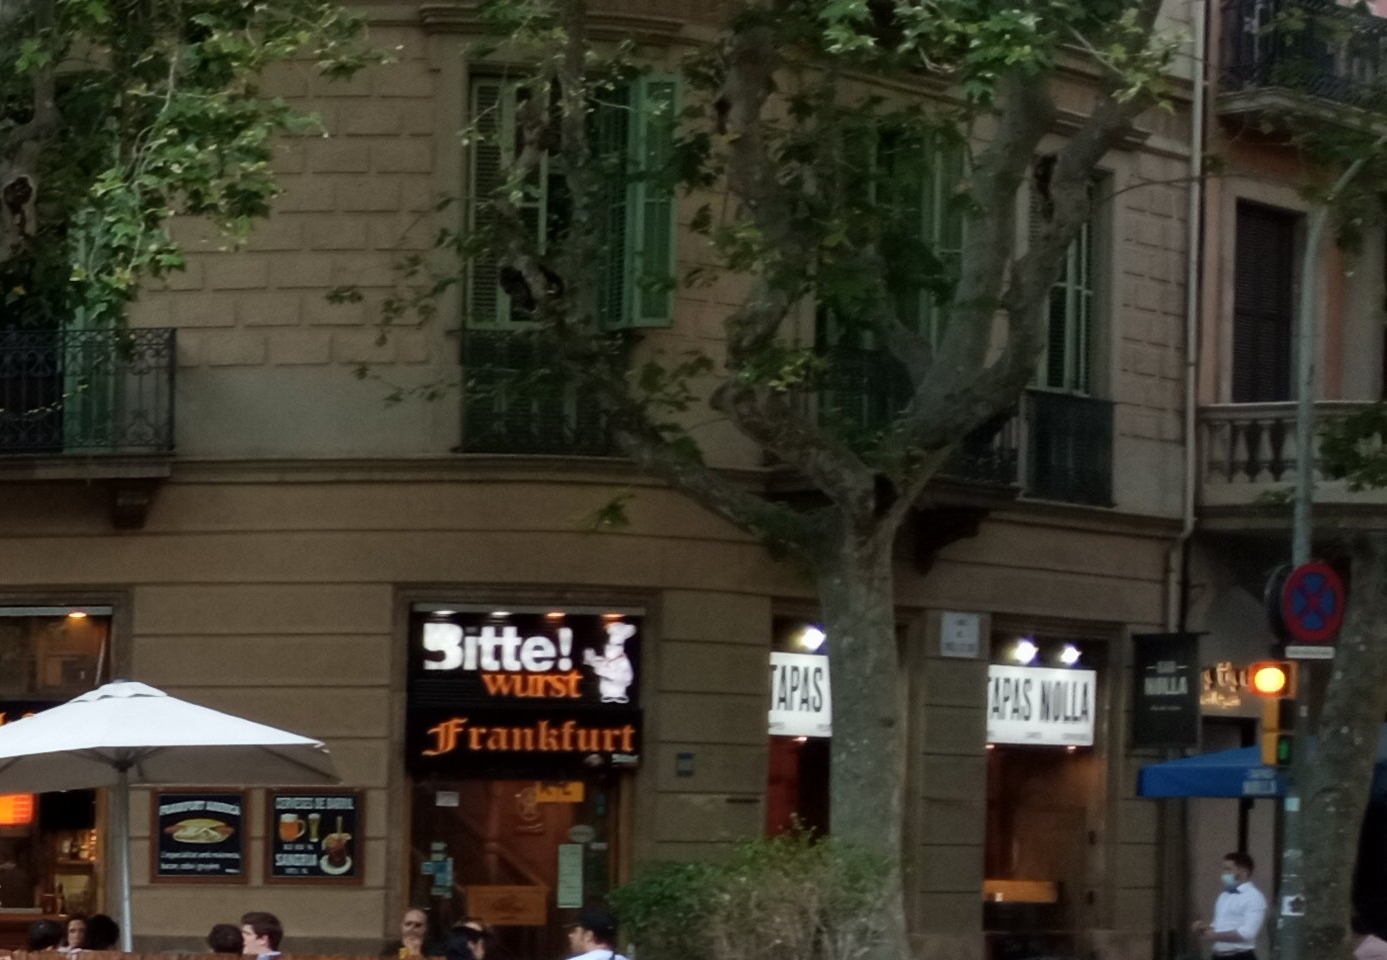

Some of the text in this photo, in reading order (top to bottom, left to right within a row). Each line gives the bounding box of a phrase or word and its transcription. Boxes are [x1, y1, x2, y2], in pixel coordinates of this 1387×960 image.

[423, 622, 573, 672] Bitte!
[481, 670, 584, 698] wurst
[1040, 680, 1089, 723] NOLLA
[421, 717, 636, 756] Frankfurt
